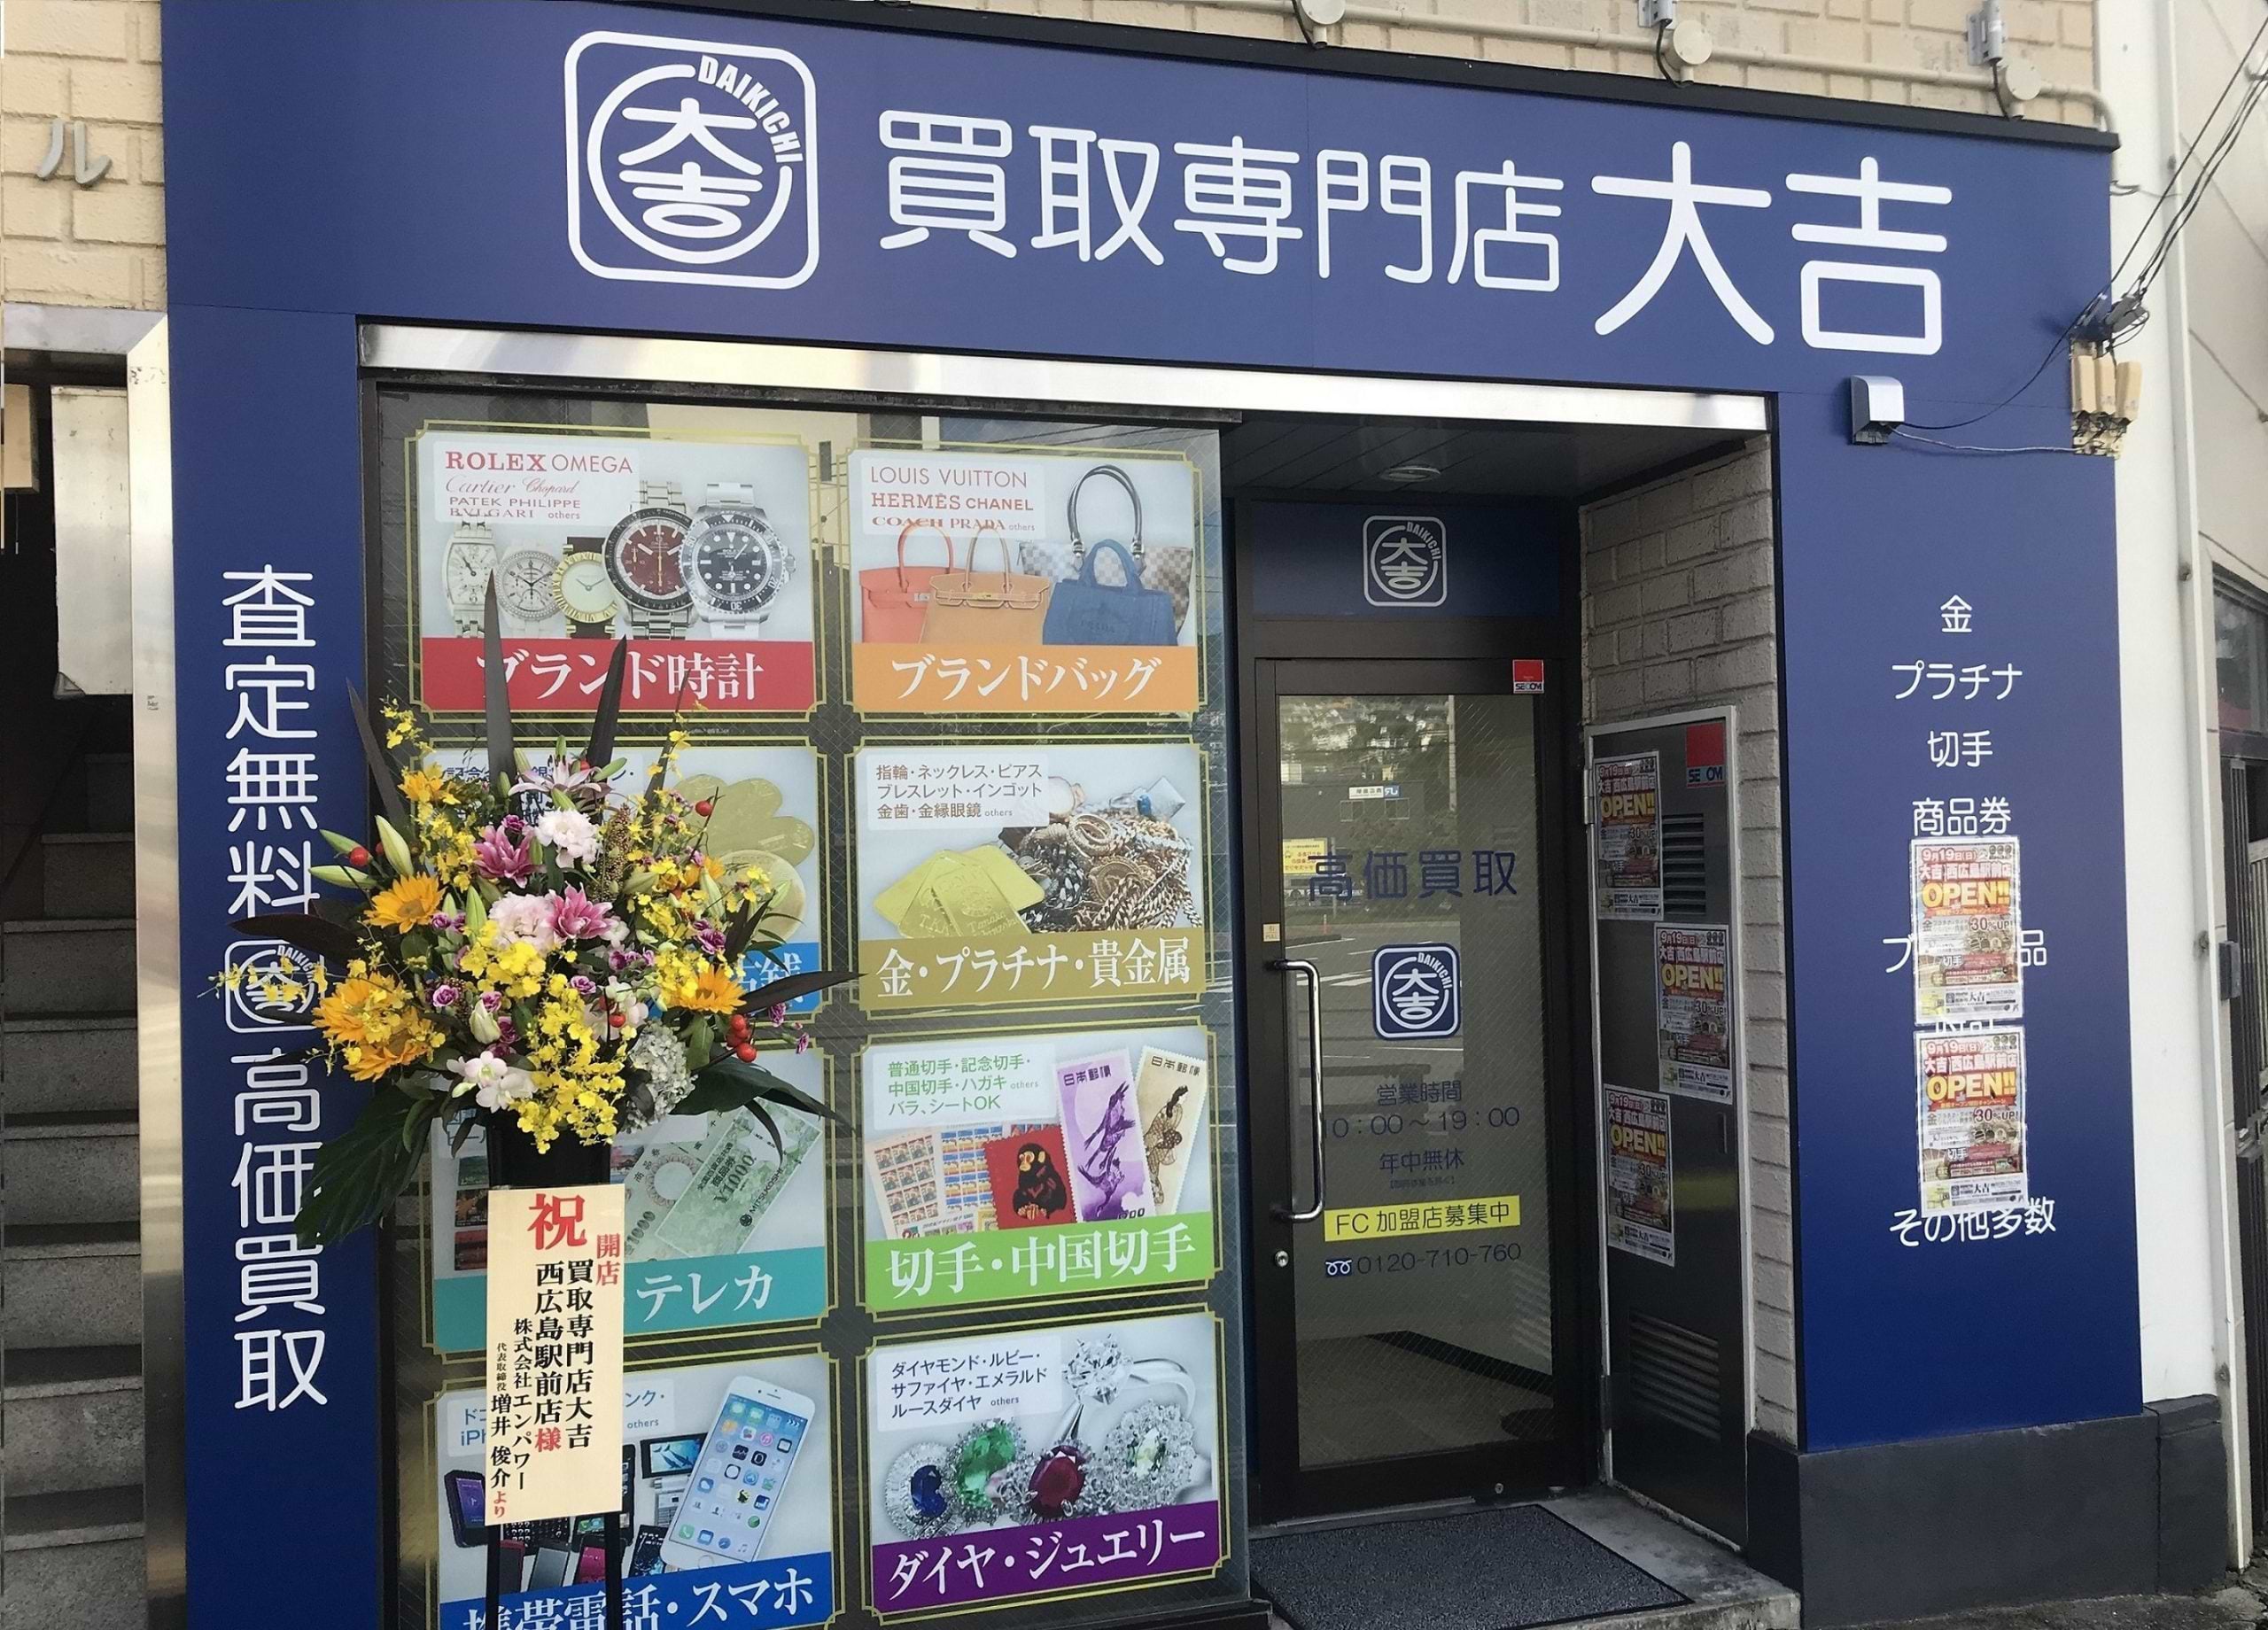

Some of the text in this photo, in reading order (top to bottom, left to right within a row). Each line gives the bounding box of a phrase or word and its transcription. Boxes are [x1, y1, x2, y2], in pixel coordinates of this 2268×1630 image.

[698, 55, 804, 163] DAIKICHI
[880, 110, 1952, 355] 買取専門店 大吉
[446, 451, 633, 474] ROLEX OMEGA
[871, 466, 1027, 488] LOUIS VUITTON
[446, 470, 580, 497] Cartier Chopard
[449, 497, 581, 508] PATEK PHILIPPE
[548, 511, 580, 520] others
[966, 497, 1034, 511] CHANEL
[872, 516, 1036, 532] COACH PRADA others
[1407, 522, 1442, 560] DAIKICHI
[1940, 594, 1972, 633] 金
[892, 653, 1162, 702] ブランドバッグ
[1891, 660, 2023, 700] プラチナ
[222, 564, 321, 918] 査定無料
[1927, 730, 1993, 768] 切手
[876, 763, 1043, 780] 指輪・ネックレス・ピアス
[878, 783, 1042, 799] ブレスレット・インゴット
[1601, 793, 1655, 818] OPEN!!
[877, 803, 982, 819] 金歯・金縁眼鏡
[1912, 796, 2012, 836] 商品券
[1308, 850, 1517, 902] 高価買取
[1922, 880, 2011, 908] OPEN!!
[876, 936, 1191, 998] 金・プラチナ・貴金属
[1418, 952, 1453, 989] DAIKICHI
[1661, 963, 1723, 991] OPEN!!
[888, 1075, 1039, 1098] 中国切手・ハガキ others
[1376, 1080, 1462, 1106] 営業時間
[1926, 1071, 2016, 1101] OPEN!!
[888, 1096, 1001, 1117] バラ、シートOK
[1611, 1124, 1666, 1157] OPEN!!
[1379, 1148, 1464, 1174] 年中無休
[230, 1047, 328, 1411] 高価買取
[528, 1193, 587, 1250] 祝
[1336, 1201, 1510, 1235] FC 加盟店募集中
[1890, 1197, 2056, 1246] その他多数
[596, 1234, 621, 1286] 開店
[886, 1222, 1196, 1300] 切手・中国切手
[1357, 1243, 1521, 1275] 0120-710-760
[565, 1258, 594, 1448] 買取専門店大吉
[891, 1367, 1048, 1399] サファイヤ・エメラルド
[891, 1394, 1020, 1419] ルースダイヤ others
[627, 1417, 659, 1429] others
[889, 1519, 1206, 1600] ダイヤ・ジュエリー
